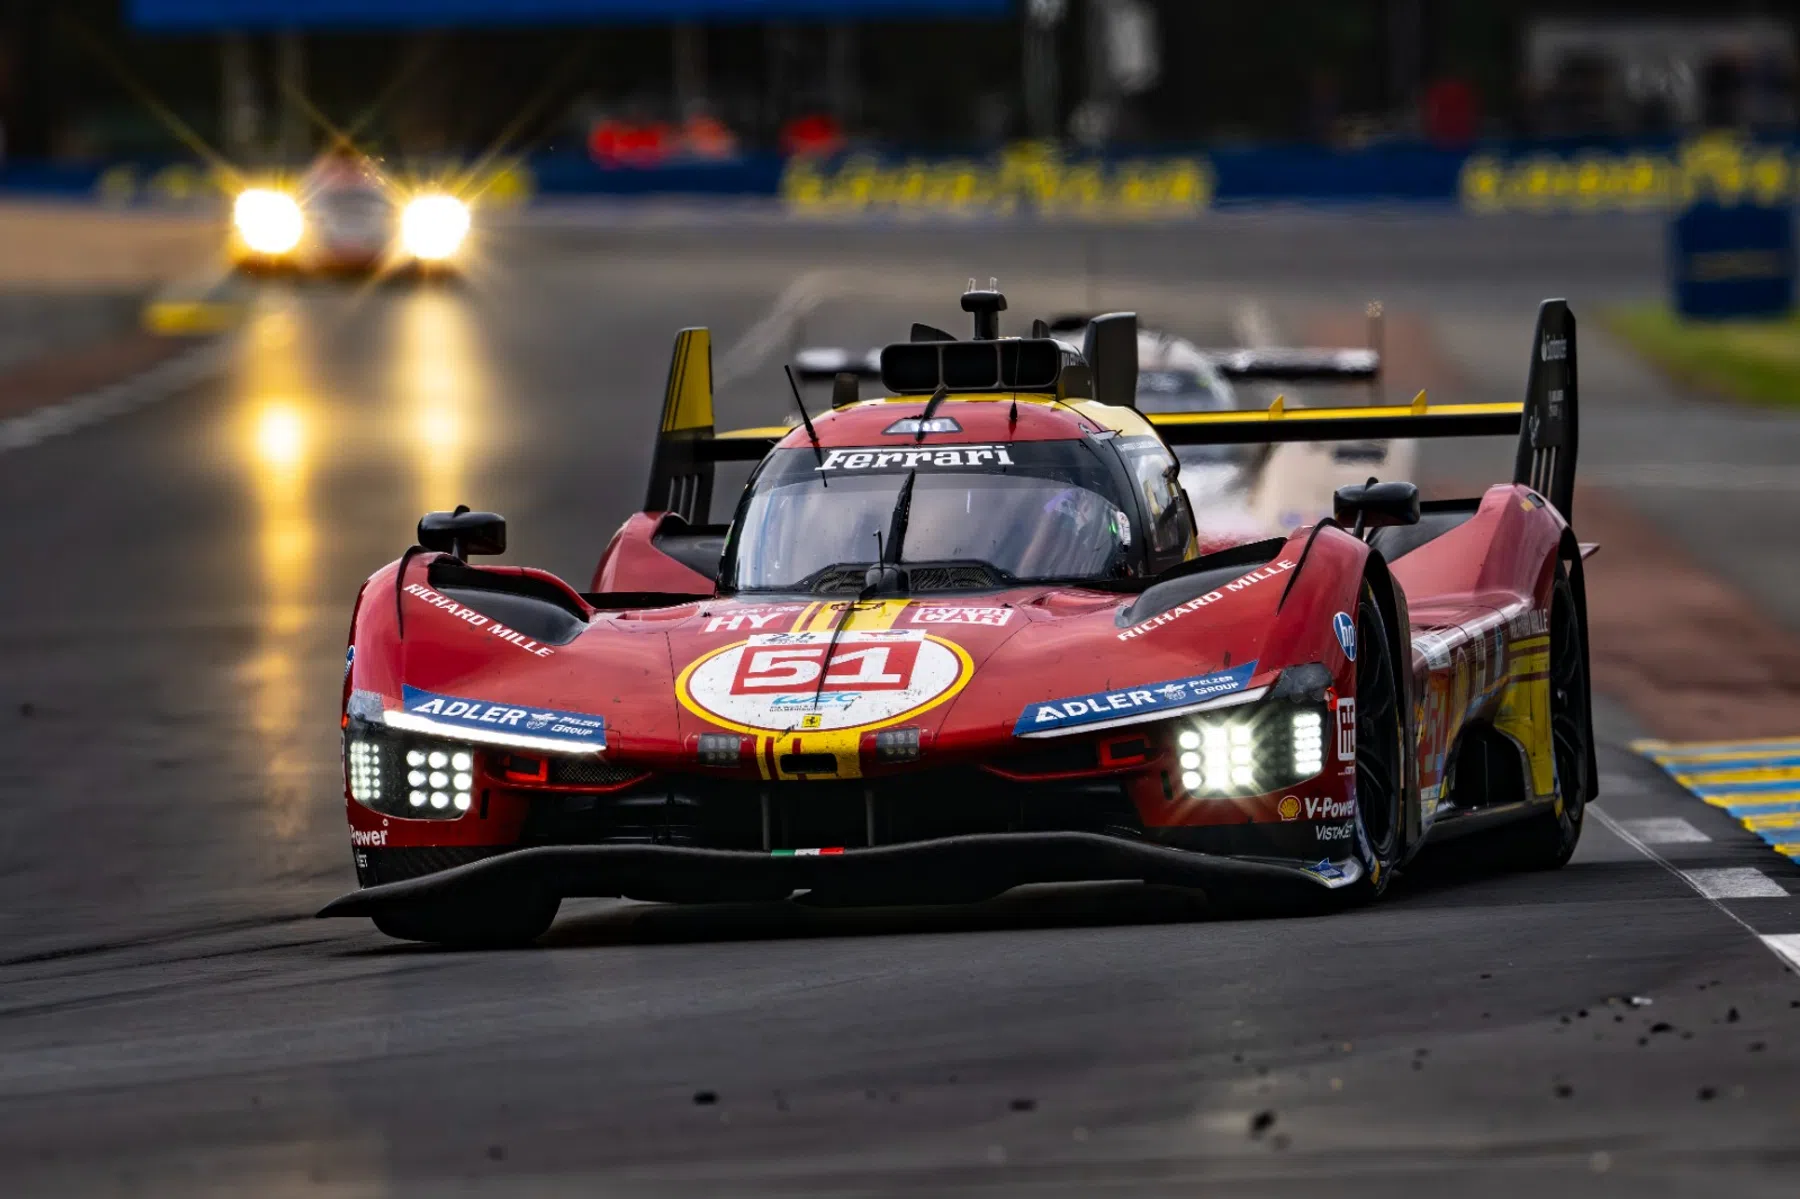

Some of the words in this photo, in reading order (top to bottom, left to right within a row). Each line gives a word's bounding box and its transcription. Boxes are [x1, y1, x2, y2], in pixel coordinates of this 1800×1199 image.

[814, 445, 1014, 471] Ferrari
[1117, 591, 1224, 641] RICHARD
[1226, 559, 1297, 592] MILLE
[403, 583, 488, 626] RICHARD
[487, 623, 554, 657] MILLE
[704, 612, 784, 632] HY
[917, 612, 1004, 625] CAR
[1338, 614, 1354, 658] hp
[743, 646, 902, 687] 51
[772, 692, 862, 706] WEC
[1034, 690, 1156, 723] ADLER
[1189, 675, 1234, 688] PELZER
[1194, 682, 1239, 695] GROUP
[412, 698, 527, 726] ADLER
[559, 716, 601, 728] PELZER
[551, 724, 593, 736] GROUP
[1304, 797, 1356, 820] V-Power
